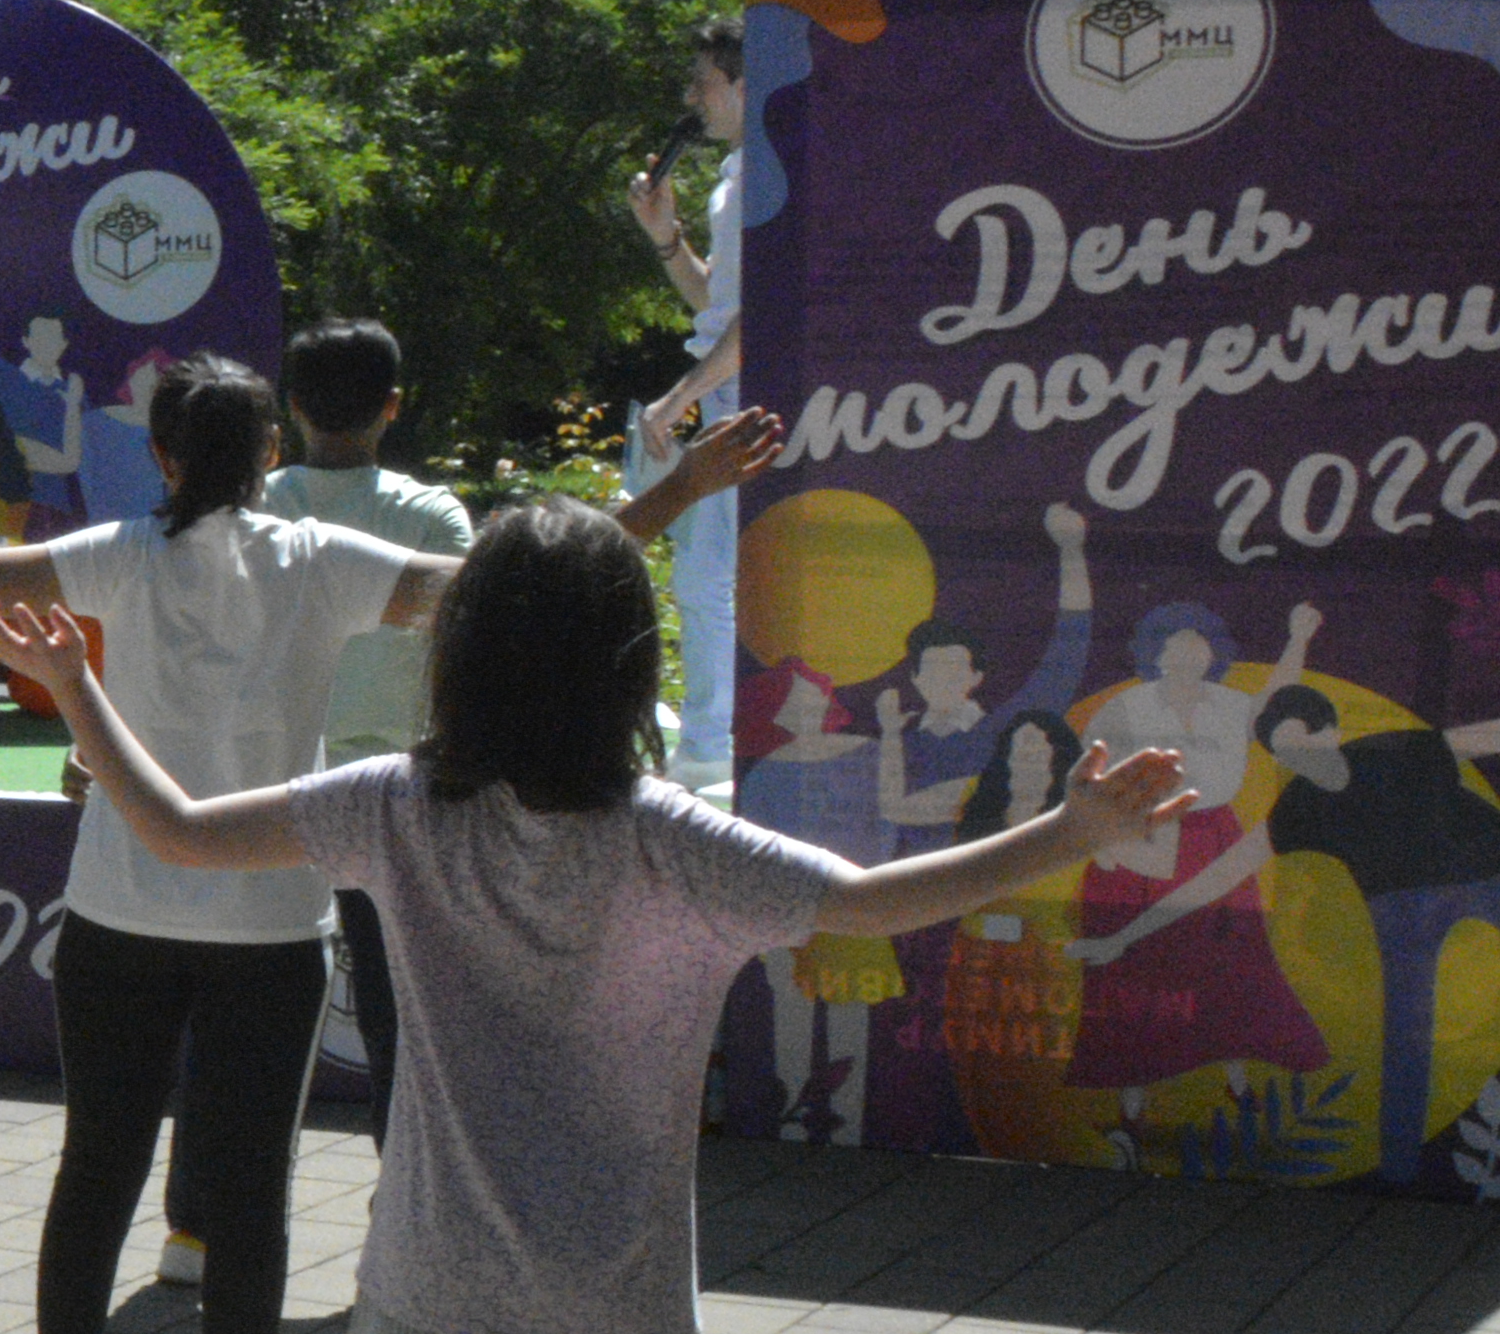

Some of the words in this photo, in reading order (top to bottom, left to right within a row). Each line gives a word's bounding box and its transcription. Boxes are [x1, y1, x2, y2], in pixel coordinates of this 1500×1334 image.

[1159, 25, 1234, 47] ММЦ
[155, 234, 212, 252] ММЦ
[920, 183, 1313, 346] День
[772, 284, 1500, 511] молодежи
[1212, 421, 1500, 564] 2022
